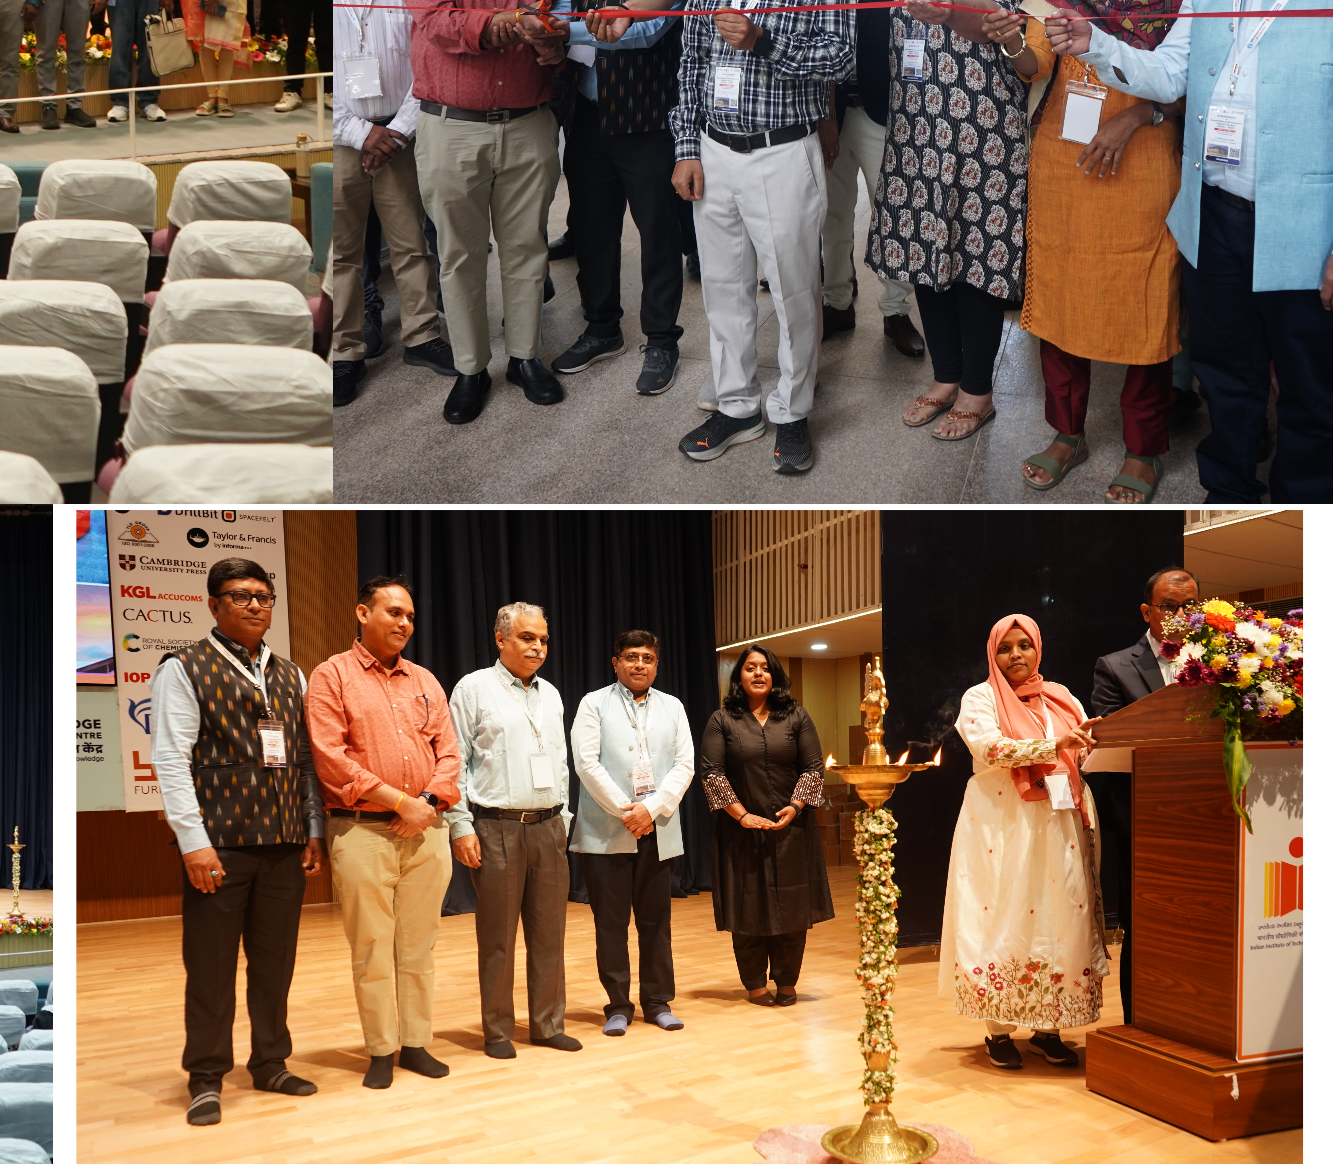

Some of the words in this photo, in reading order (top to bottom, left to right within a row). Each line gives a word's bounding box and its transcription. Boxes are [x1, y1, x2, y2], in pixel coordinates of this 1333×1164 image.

[212, 532, 237, 541] Taylor
[248, 535, 276, 544] Francis
[140, 556, 207, 568] CAMBRIDGE
[141, 565, 184, 573] UNIVERSITY
[120, 585, 156, 599] KGL
[158, 594, 203, 602] ACCUCOMS
[124, 672, 151, 683] IOP
